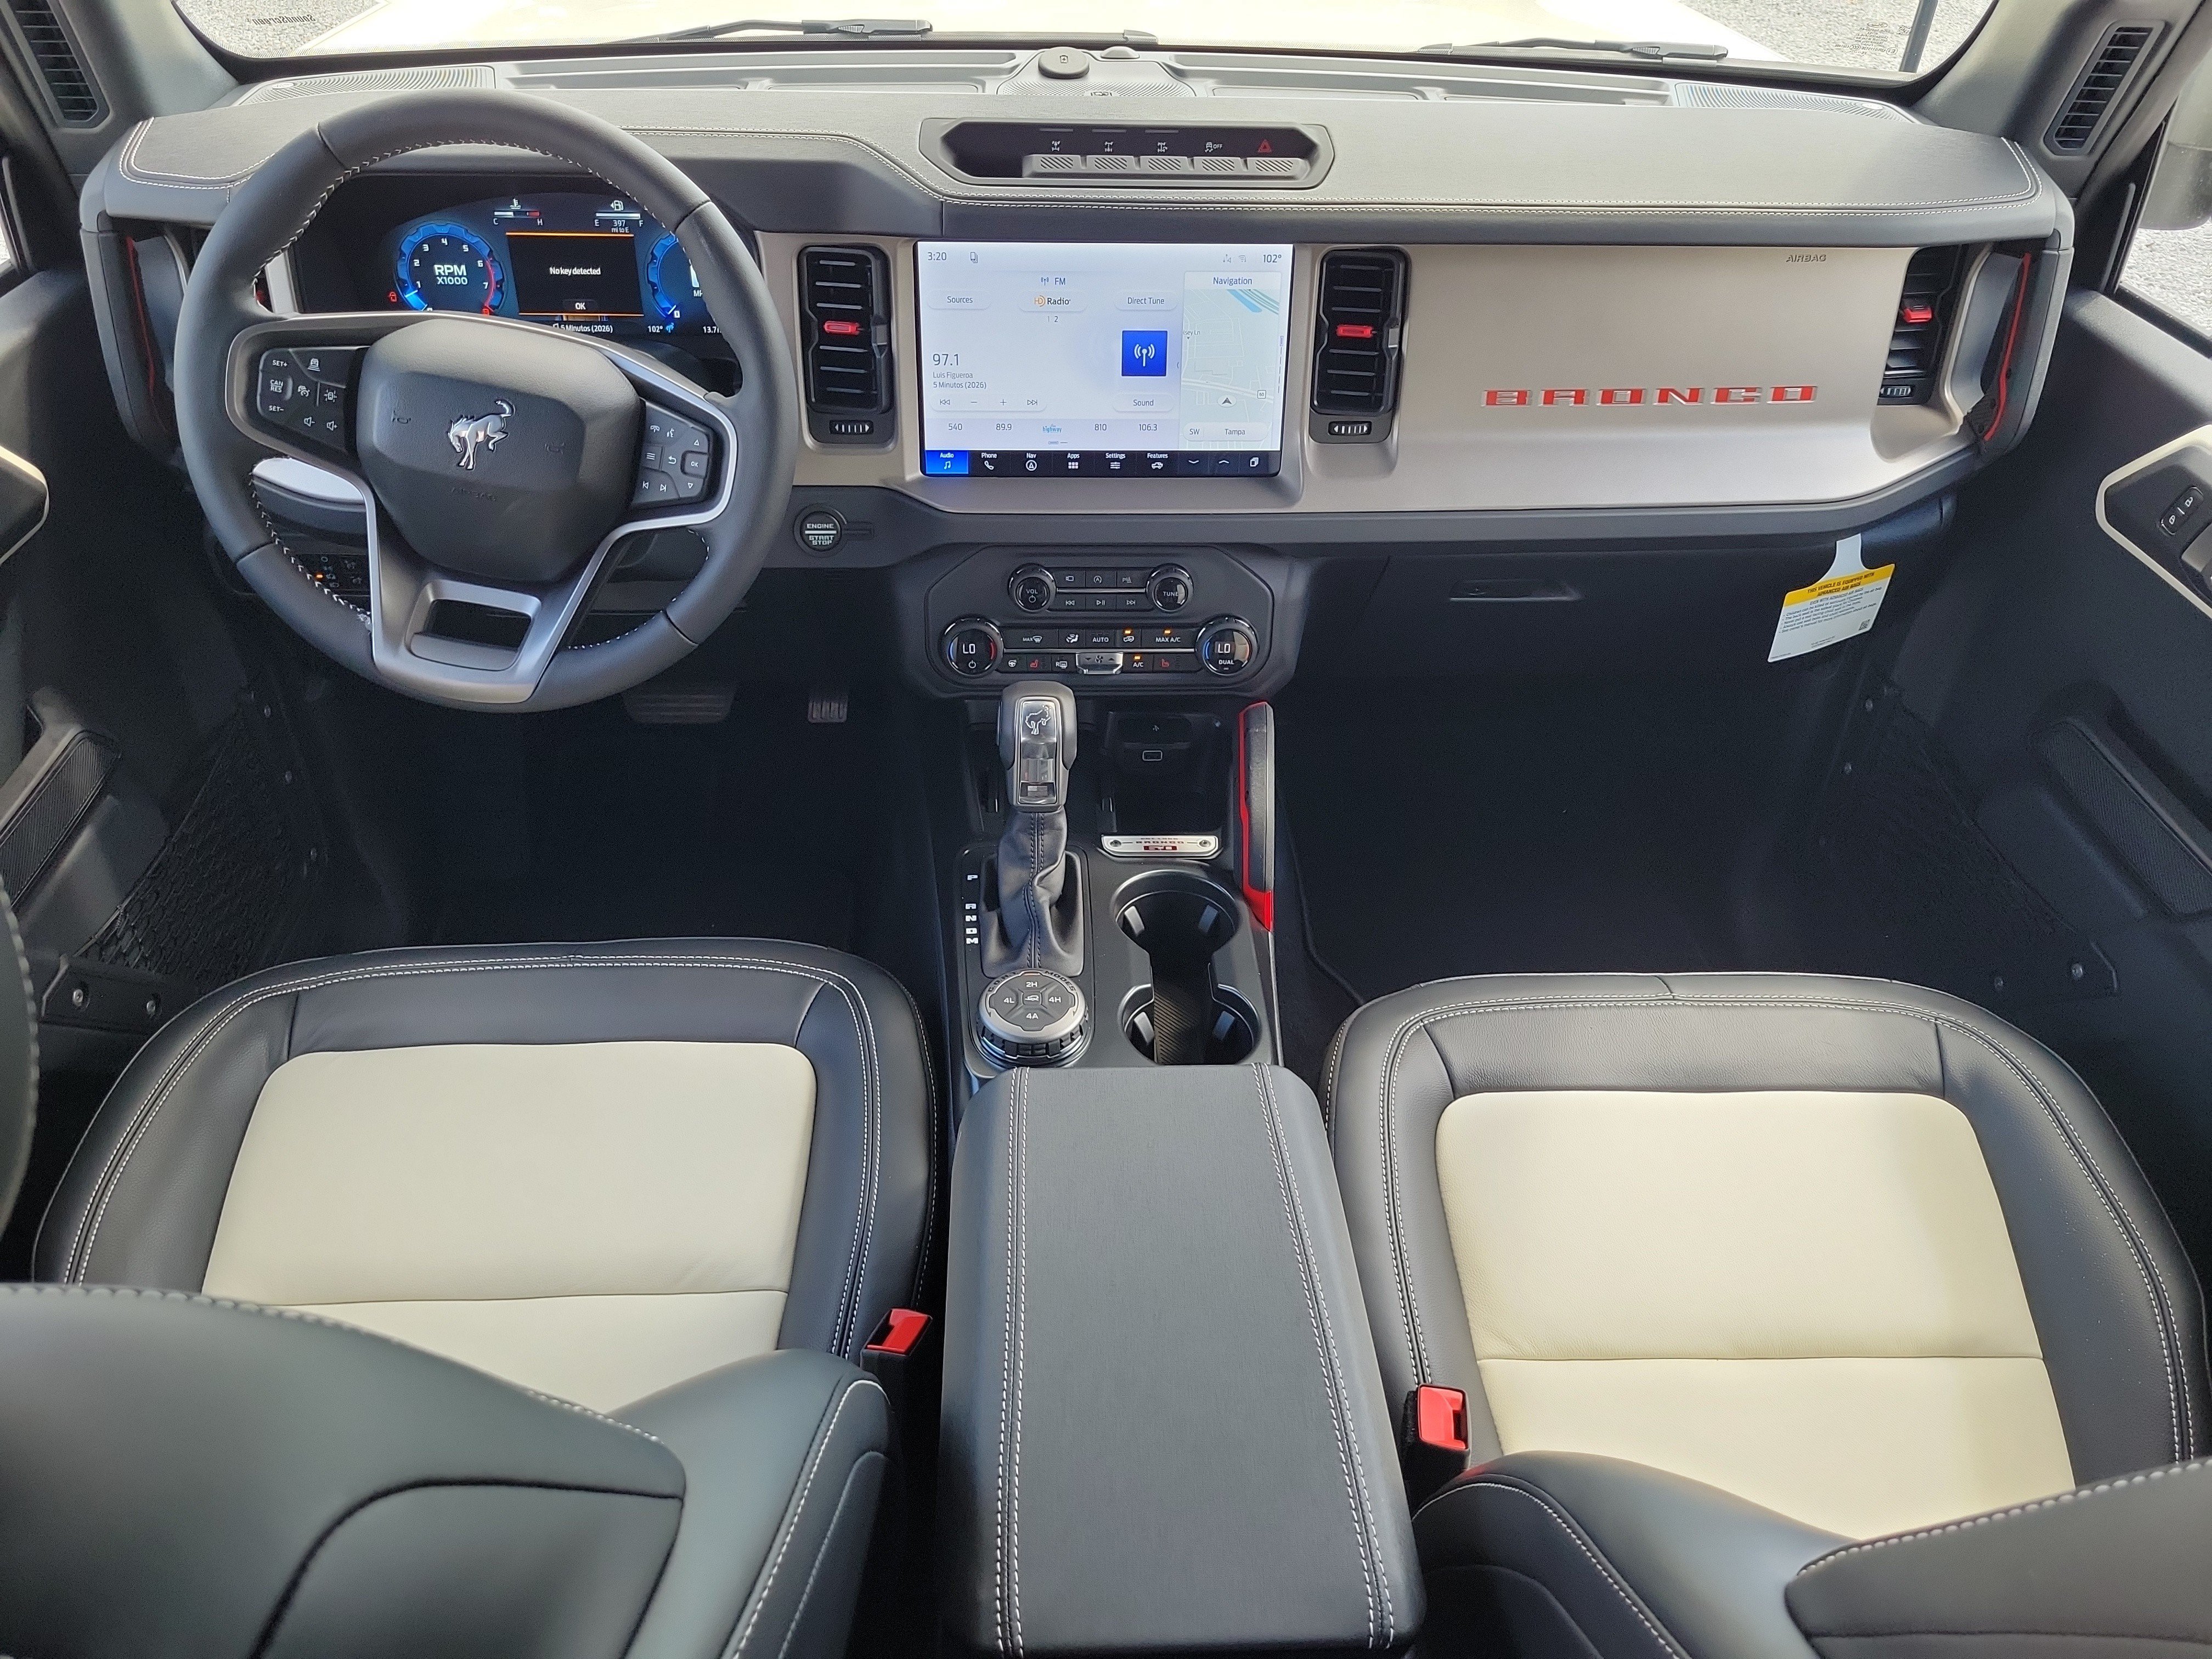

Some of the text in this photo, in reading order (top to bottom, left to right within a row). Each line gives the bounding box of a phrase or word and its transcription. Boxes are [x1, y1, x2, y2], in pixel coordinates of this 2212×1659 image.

[927, 251, 947, 261] 3:20
[1263, 254, 1282, 263] 102°
[1786, 254, 1826, 262] AIRBAG
[434, 264, 466, 276] RPM
[560, 268, 572, 276] key
[437, 276, 468, 285] X1000
[1213, 276, 1252, 286] Navigation
[591, 325, 613, 334] (2026)
[272, 359, 288, 368] SET+
[933, 353, 960, 366] 97.1
[1481, 386, 1818, 407] BRONCO
[1842, 576, 1863, 584] EQUIPPED
[962, 644, 975, 654] LO
[1218, 643, 1230, 653] LO
[1045, 970, 1076, 992] MODES
